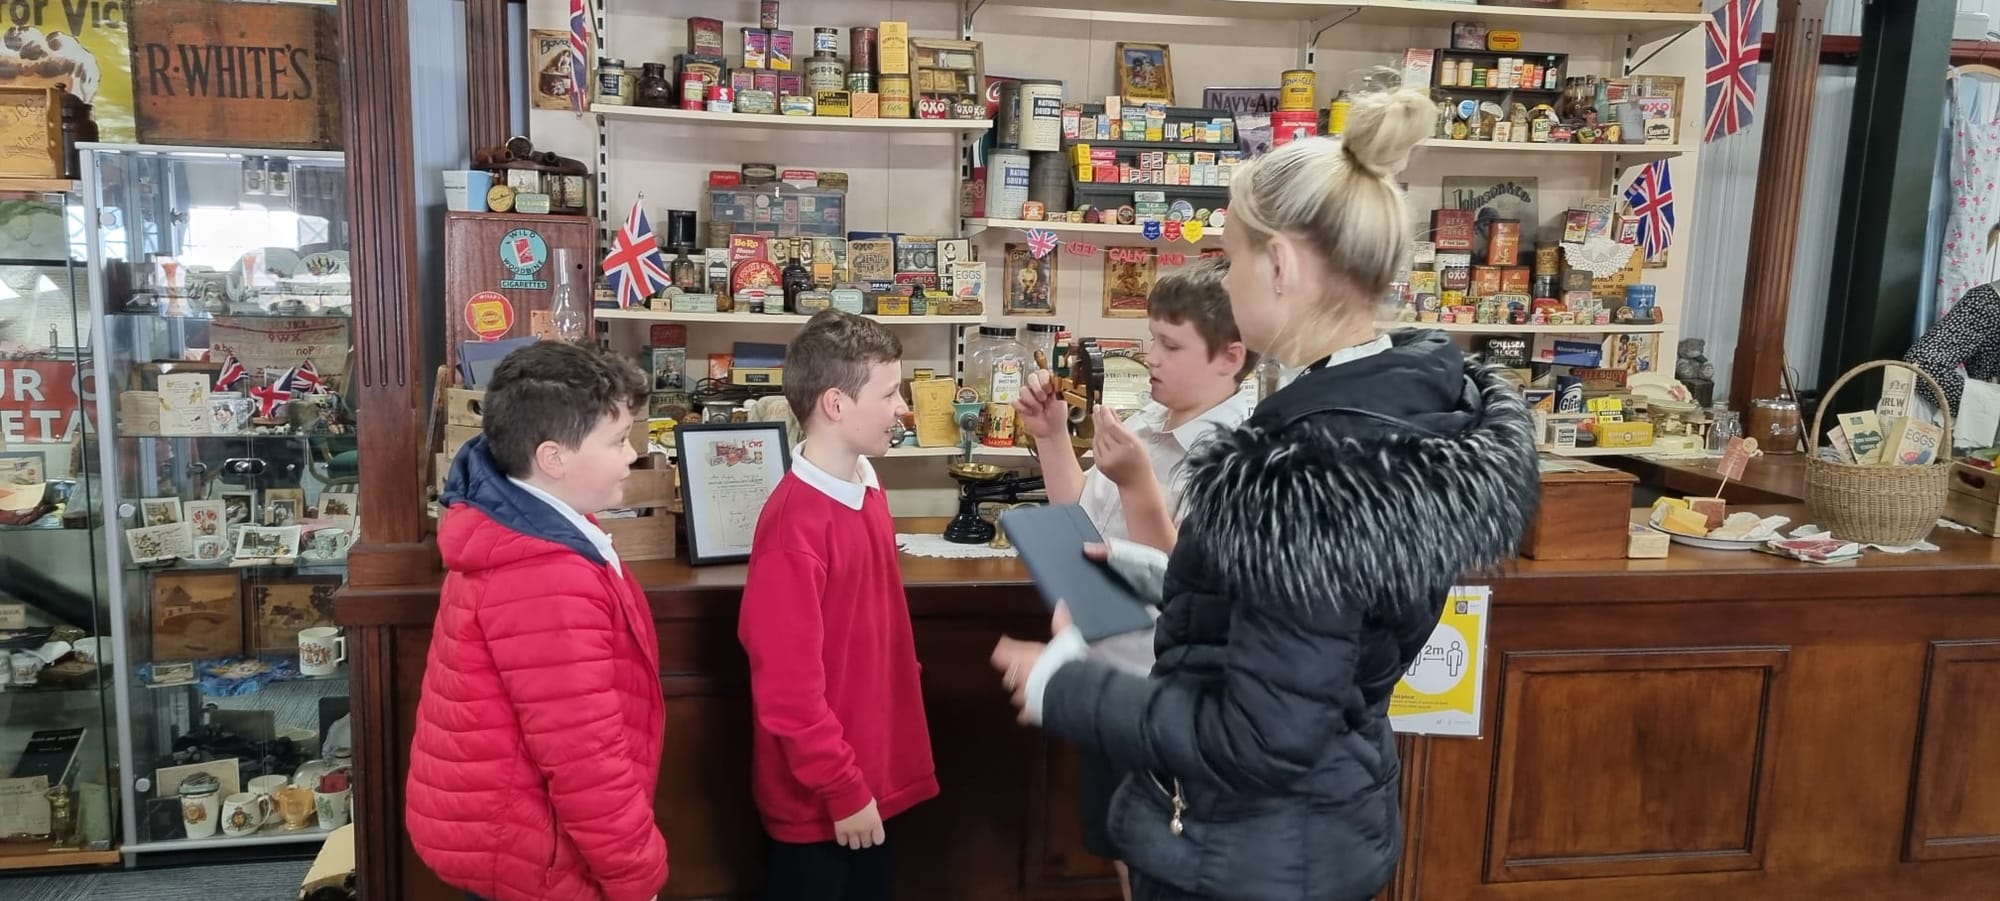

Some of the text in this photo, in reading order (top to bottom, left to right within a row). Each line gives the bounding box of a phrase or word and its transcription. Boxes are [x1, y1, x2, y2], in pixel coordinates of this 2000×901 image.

[921, 101, 945, 114] OXO
[1211, 92, 1251, 113] NAVY
[956, 105, 974, 115] OXO
[1164, 122, 1178, 139] LUX
[509, 230, 536, 239] WILD
[1065, 240, 1098, 256] KEEP
[1109, 248, 1147, 263] CALM
[1157, 252, 1186, 266] AND
[503, 256, 542, 274] WOODBINE
[956, 271, 982, 280] EGGS
[1448, 270, 1467, 281] OXO
[502, 281, 547, 289] CIGARETTES
[1904, 428, 1937, 449] EGGS
[1424, 644, 1444, 656] 2m
